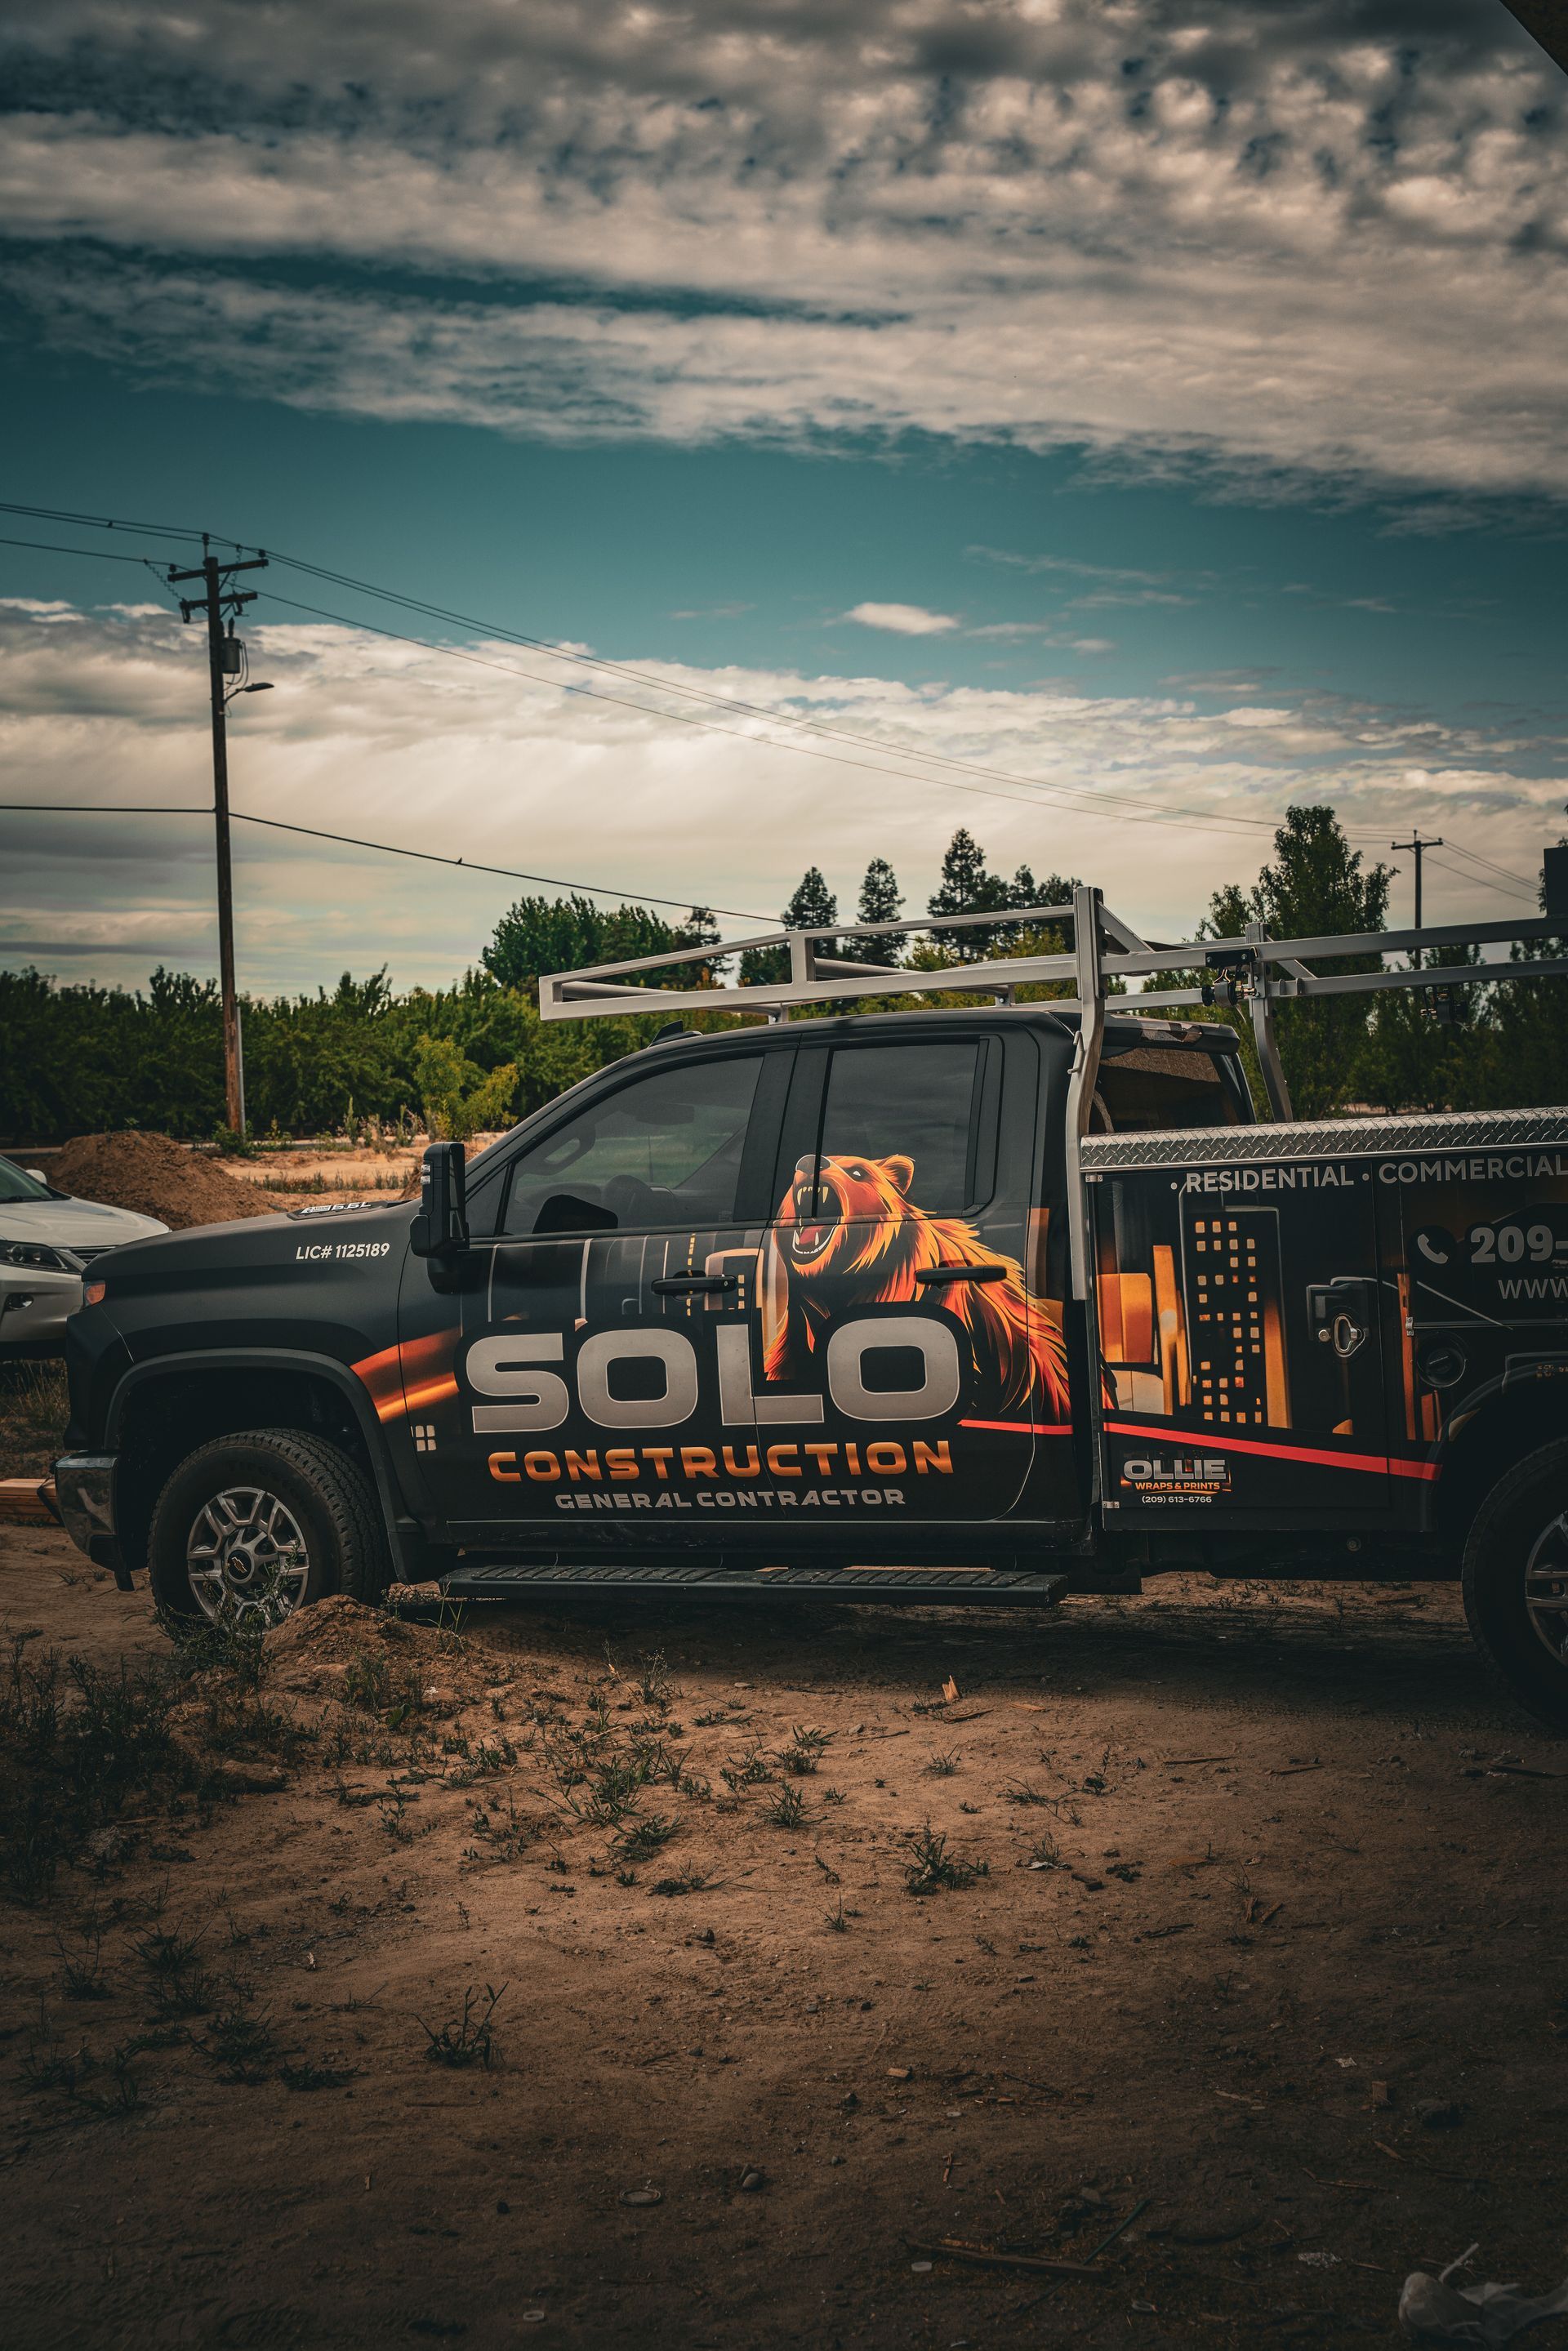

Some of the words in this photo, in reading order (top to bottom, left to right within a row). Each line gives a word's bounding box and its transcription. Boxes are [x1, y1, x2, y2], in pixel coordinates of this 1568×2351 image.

[1186, 1165, 1354, 1193] RESIDENTIAL
[1379, 1155, 1568, 1184] COMMERCIAL
[296, 1245, 332, 1260] LIC#
[336, 1242, 390, 1258] 1125189
[466, 1316, 960, 1433] SOLO
[488, 1440, 954, 1482] CONSTRUCTION
[1124, 1459, 1227, 1480] OLLIE
[1135, 1482, 1173, 1490] WRAPS
[1174, 1482, 1182, 1490] &
[1183, 1481, 1221, 1490] PRINTS
[555, 1492, 693, 1509] GENERAL
[697, 1489, 906, 1507] CONTRACTOR
[1142, 1495, 1166, 1504] (209)
[1168, 1495, 1213, 1503] 613-6766
